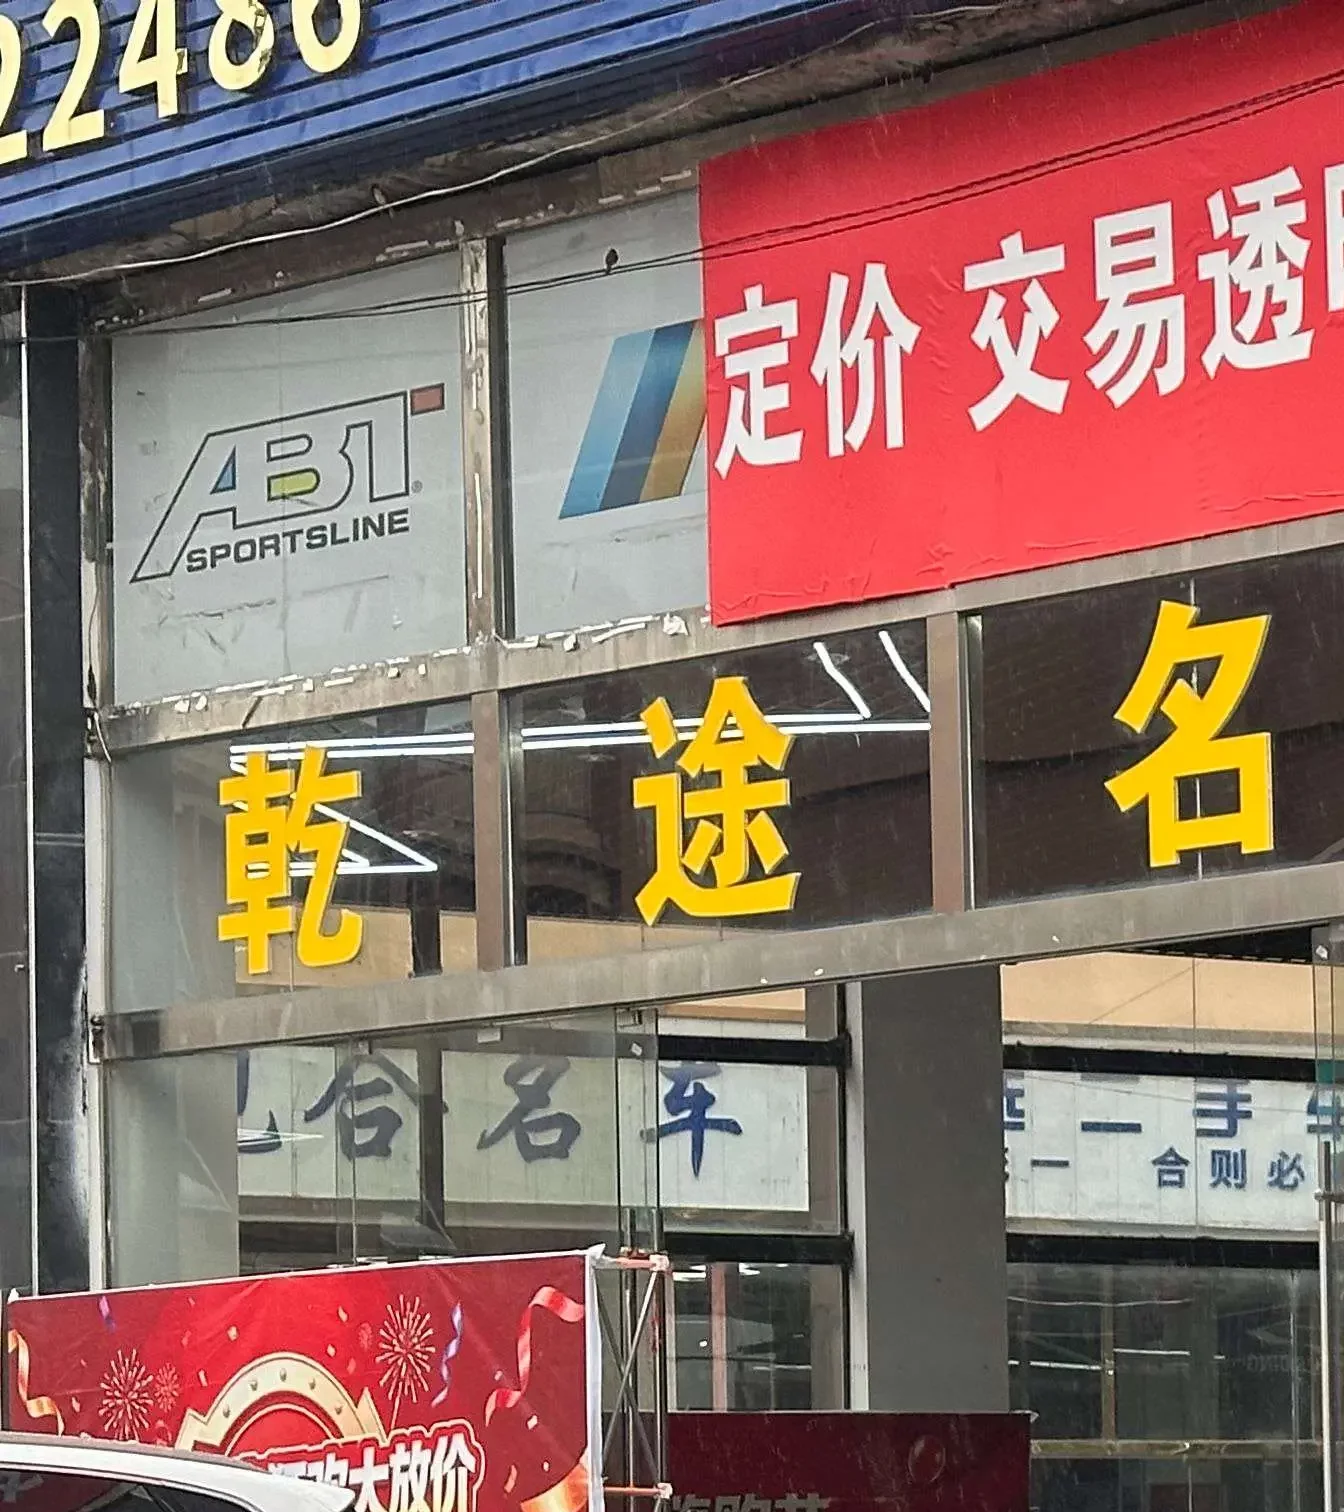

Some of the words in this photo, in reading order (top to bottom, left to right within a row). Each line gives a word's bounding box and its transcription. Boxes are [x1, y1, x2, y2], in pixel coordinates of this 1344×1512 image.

[713, 263, 921, 480] 定价
[129, 383, 445, 584] ABT
[185, 507, 411, 574] SPORTSLINE
